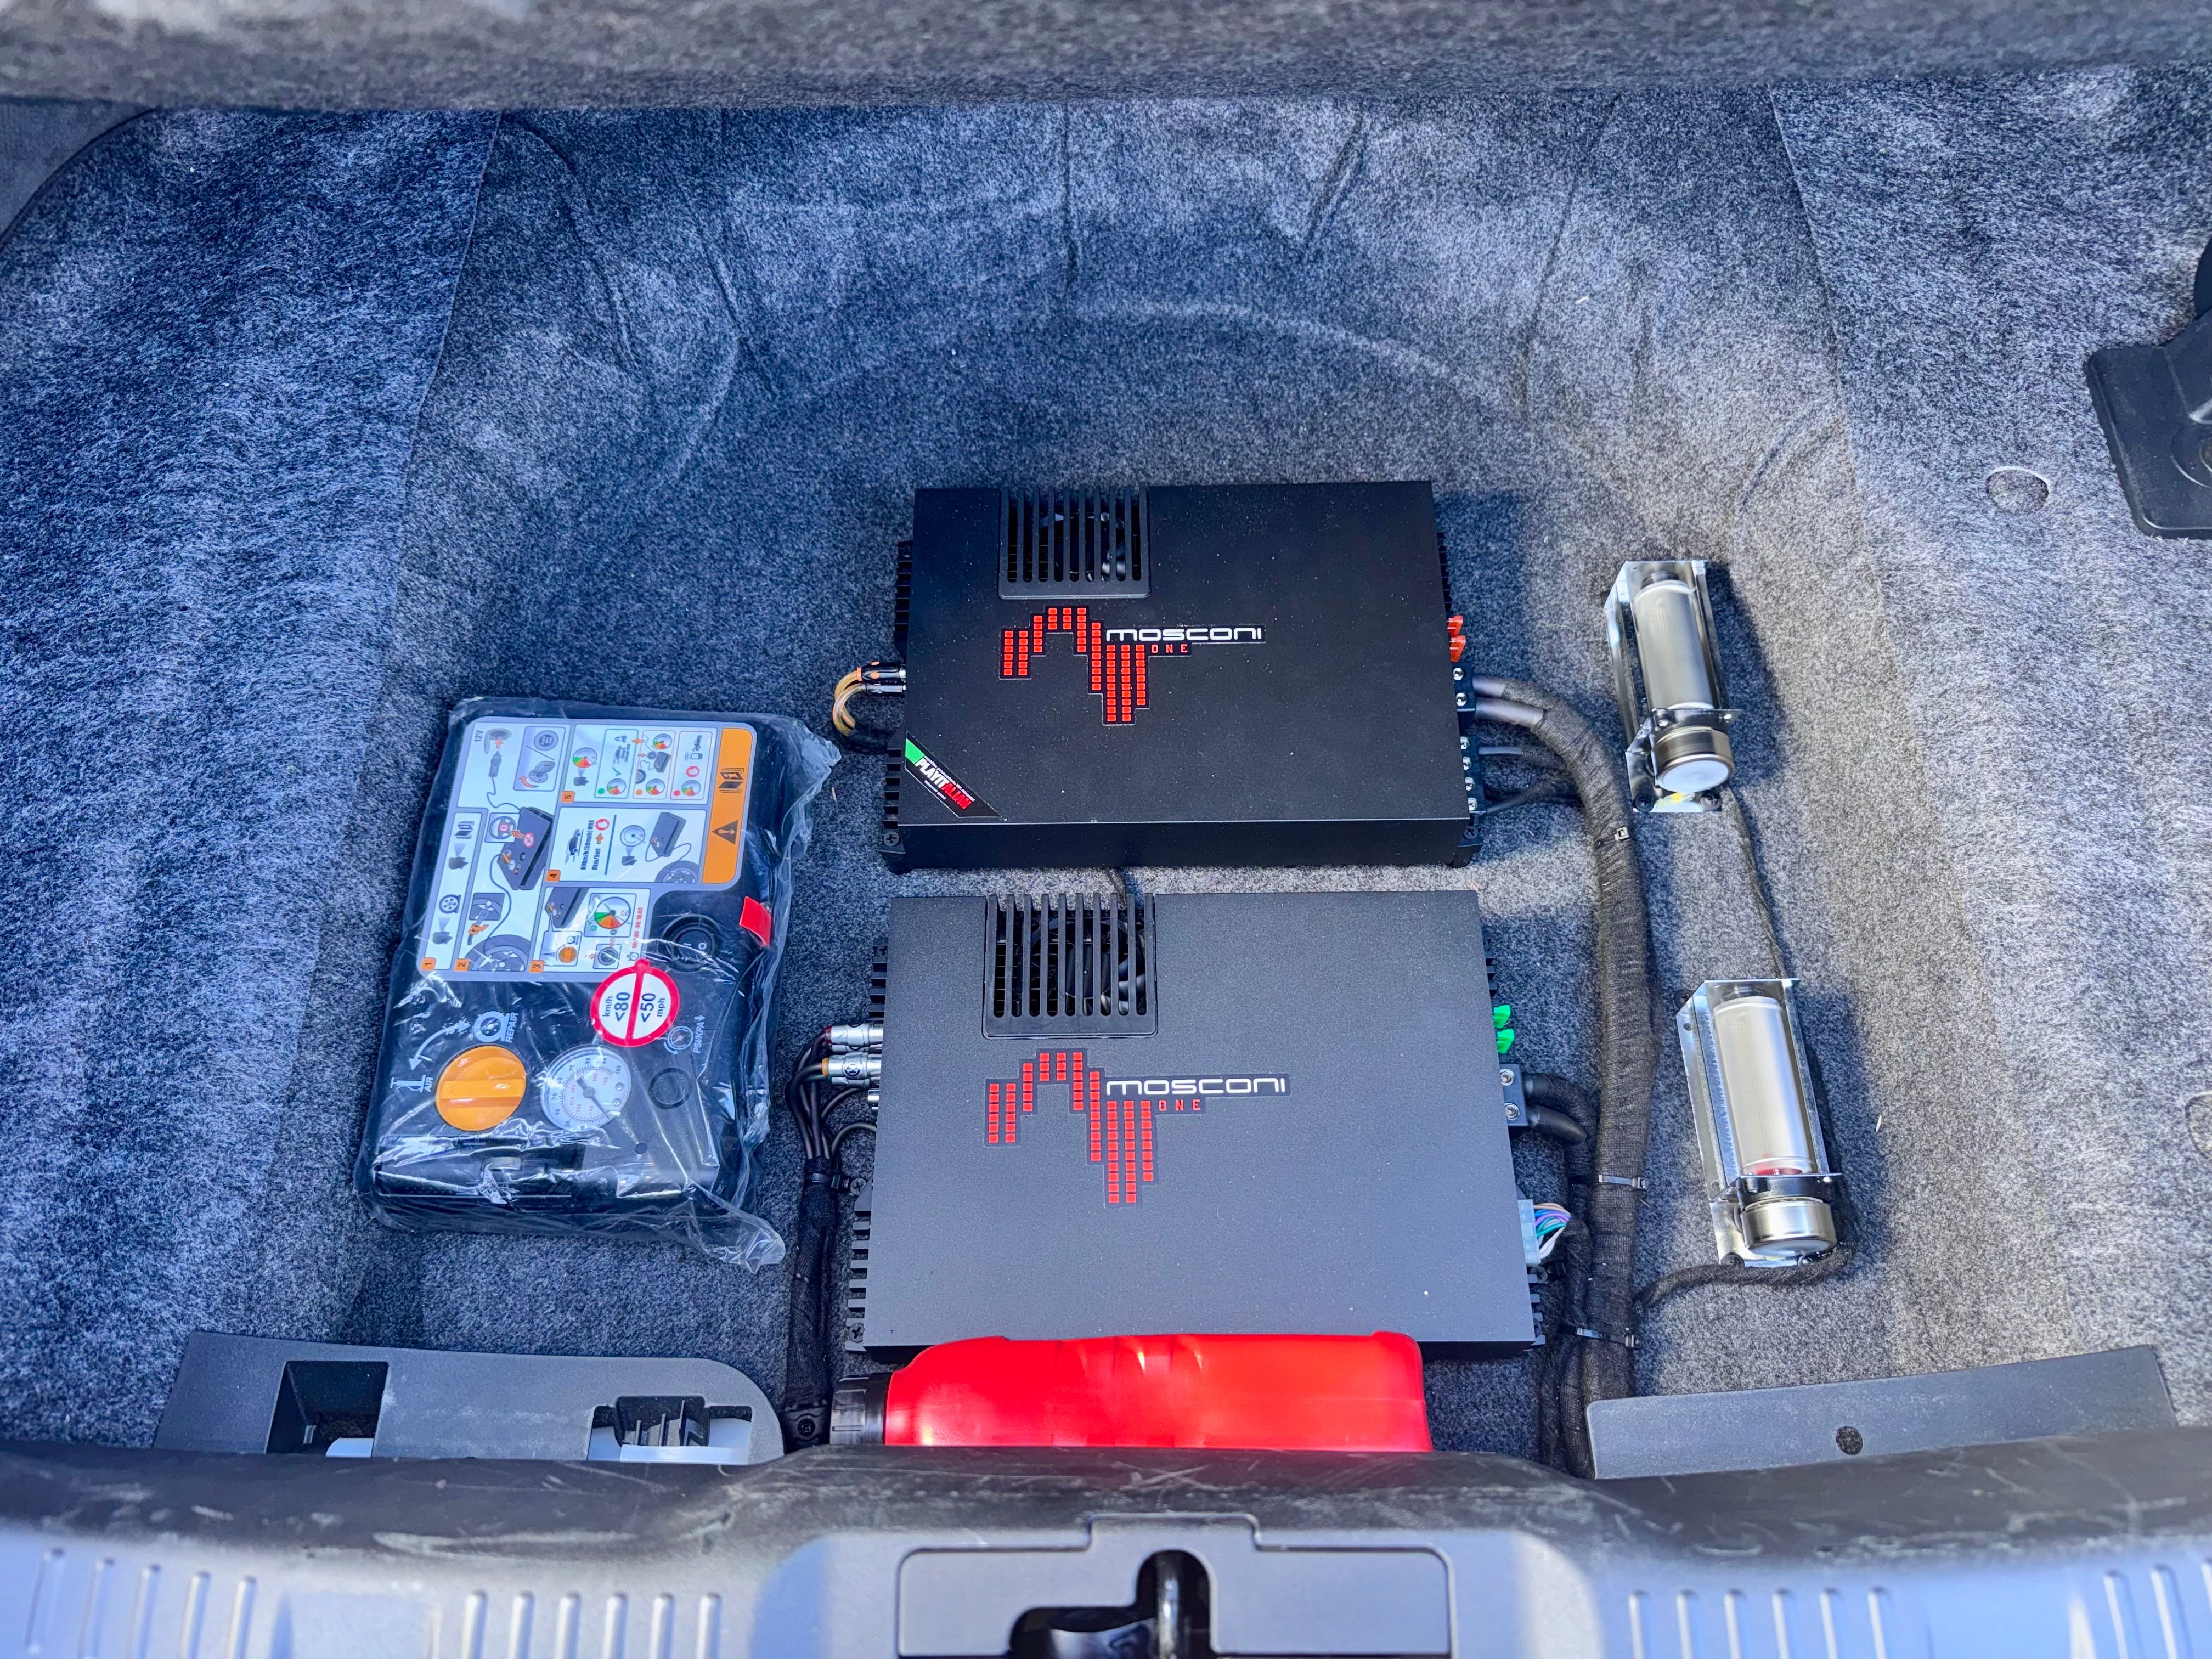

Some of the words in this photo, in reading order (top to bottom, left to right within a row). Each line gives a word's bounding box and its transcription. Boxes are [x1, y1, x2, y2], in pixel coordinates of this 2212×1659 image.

[1106, 628, 1262, 641] mosconi
[1151, 644, 1188, 653] ONE
[474, 730, 483, 742] 12V
[915, 758, 972, 810] PLAYITALIAN
[602, 996, 613, 1017] km/h
[614, 992, 630, 1022] <80
[640, 993, 656, 1022] <50
[657, 998, 665, 1017] mph
[504, 1012, 518, 1043] REPAIR
[693, 1022, 704, 1054] PSI/KPA
[424, 1077, 433, 1092] AIR
[1106, 1078, 1285, 1096] mosconi
[1159, 1099, 1200, 1111] ONE
